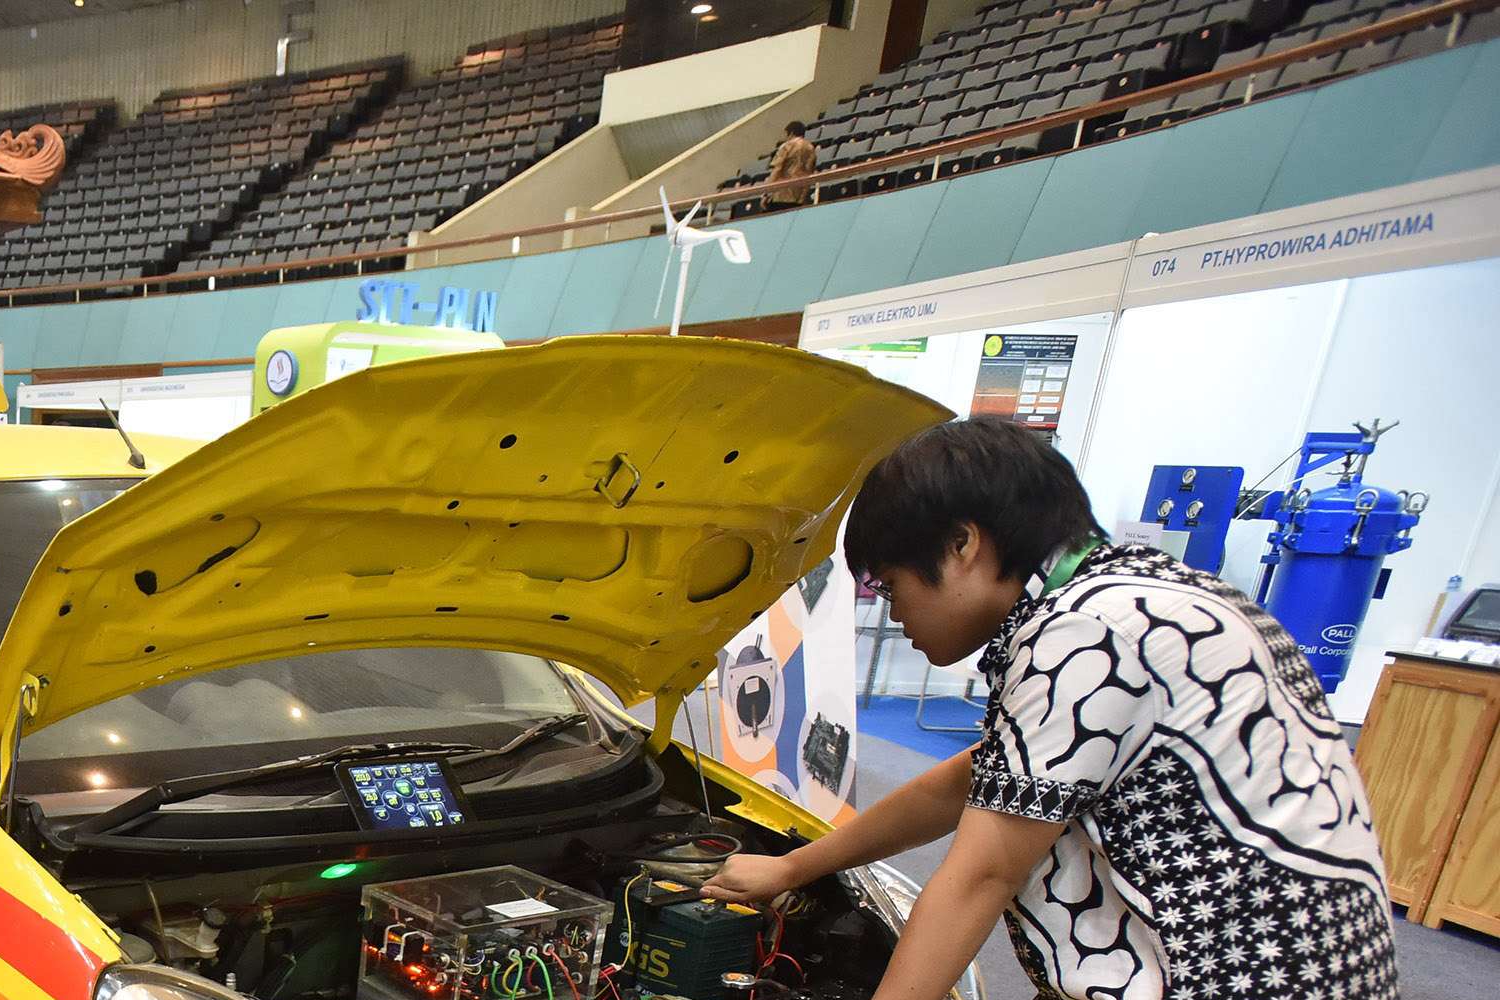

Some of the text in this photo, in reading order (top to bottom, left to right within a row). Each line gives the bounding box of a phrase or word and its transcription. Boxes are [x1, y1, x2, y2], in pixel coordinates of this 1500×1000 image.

[1152, 213, 1434, 276] 074 PT.HYPROWIRA ADHITAMA
[356, 280, 497, 333] STT-PLN
[847, 313, 875, 328] TEKNIK
[876, 305, 916, 323] ELEKTRO
[918, 302, 937, 317] UMJ
[1328, 629, 1354, 638] PALL
[1298, 644, 1318, 655] Pall
[629, 941, 671, 978] GS
